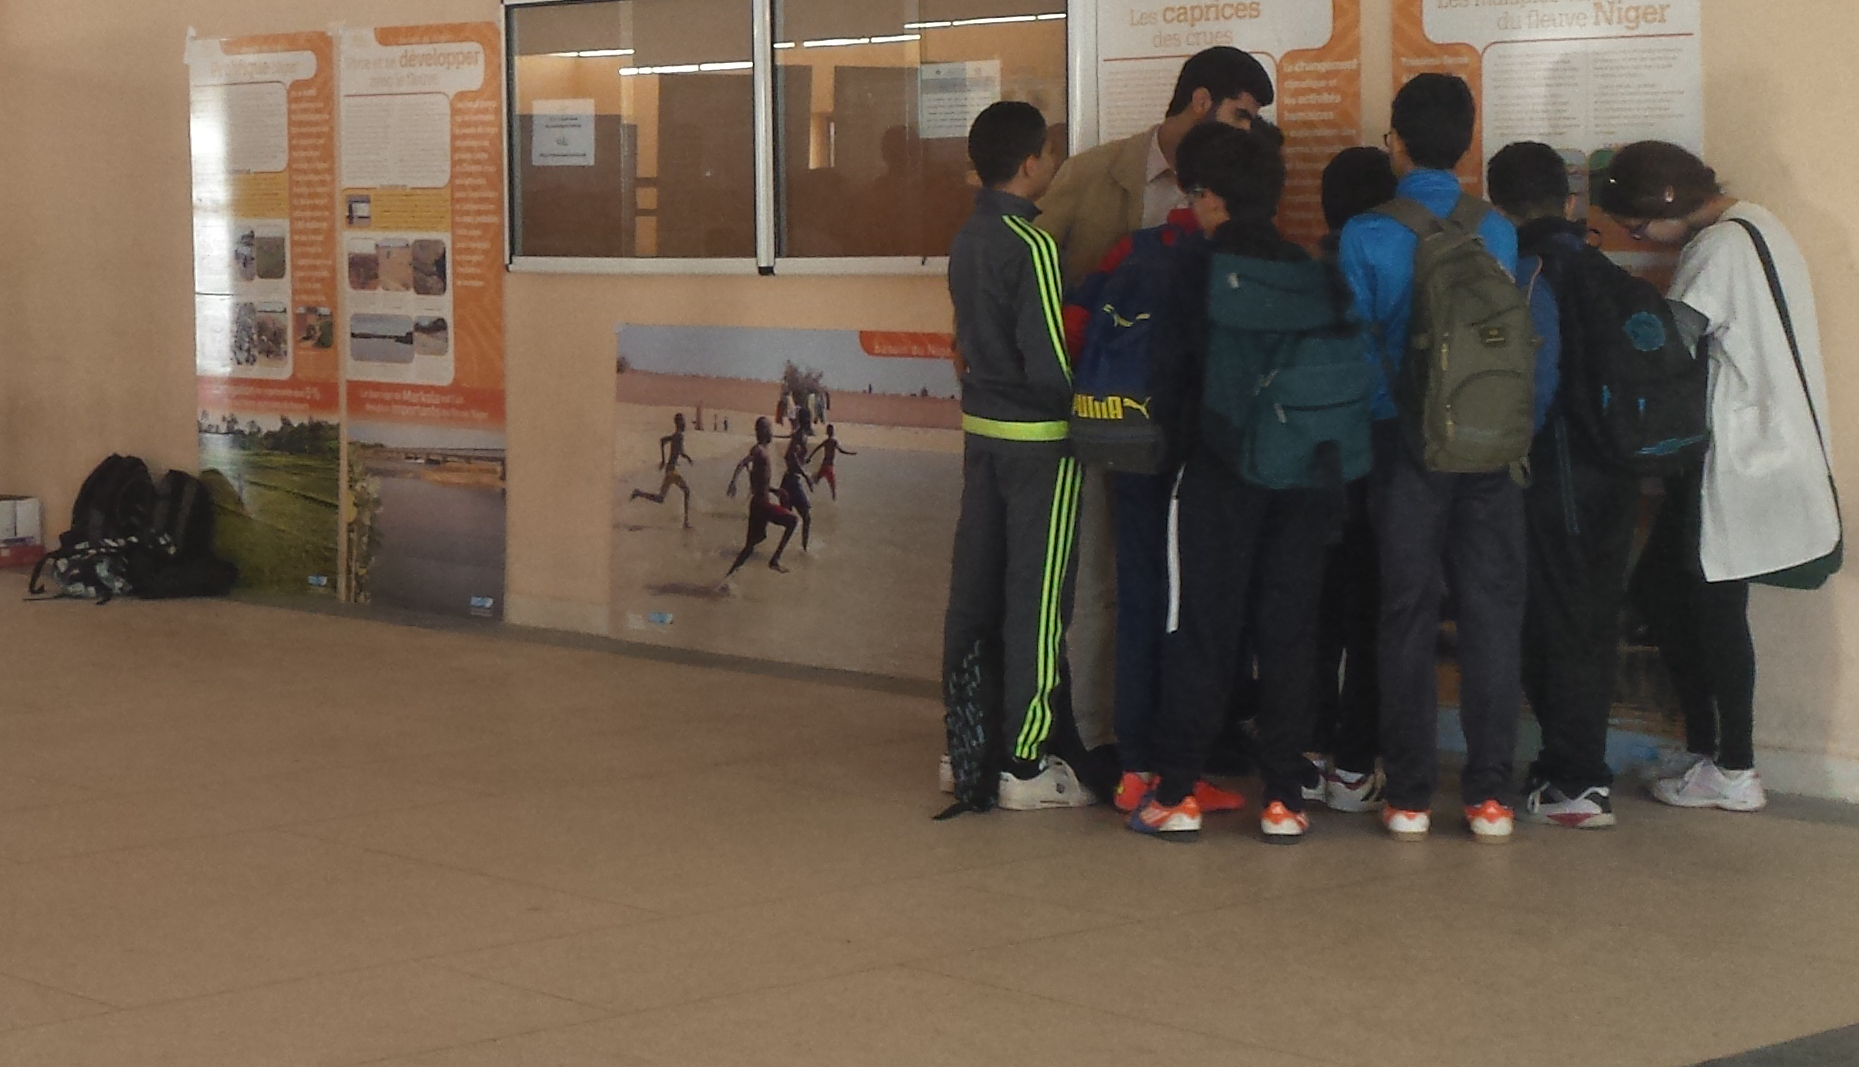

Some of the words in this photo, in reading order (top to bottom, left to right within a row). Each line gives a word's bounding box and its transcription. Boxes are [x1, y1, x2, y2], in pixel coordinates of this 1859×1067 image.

[1130, 9, 1158, 27] Les
[1162, 0, 1261, 28] caprices
[1497, 11, 1522, 30] du
[1527, 9, 1588, 29] fleuve
[1593, 0, 1671, 31] Niger
[1152, 30, 1184, 48] des
[1186, 28, 1235, 47] crues
[399, 47, 481, 70] développer
[1072, 392, 1123, 420] PUMA
